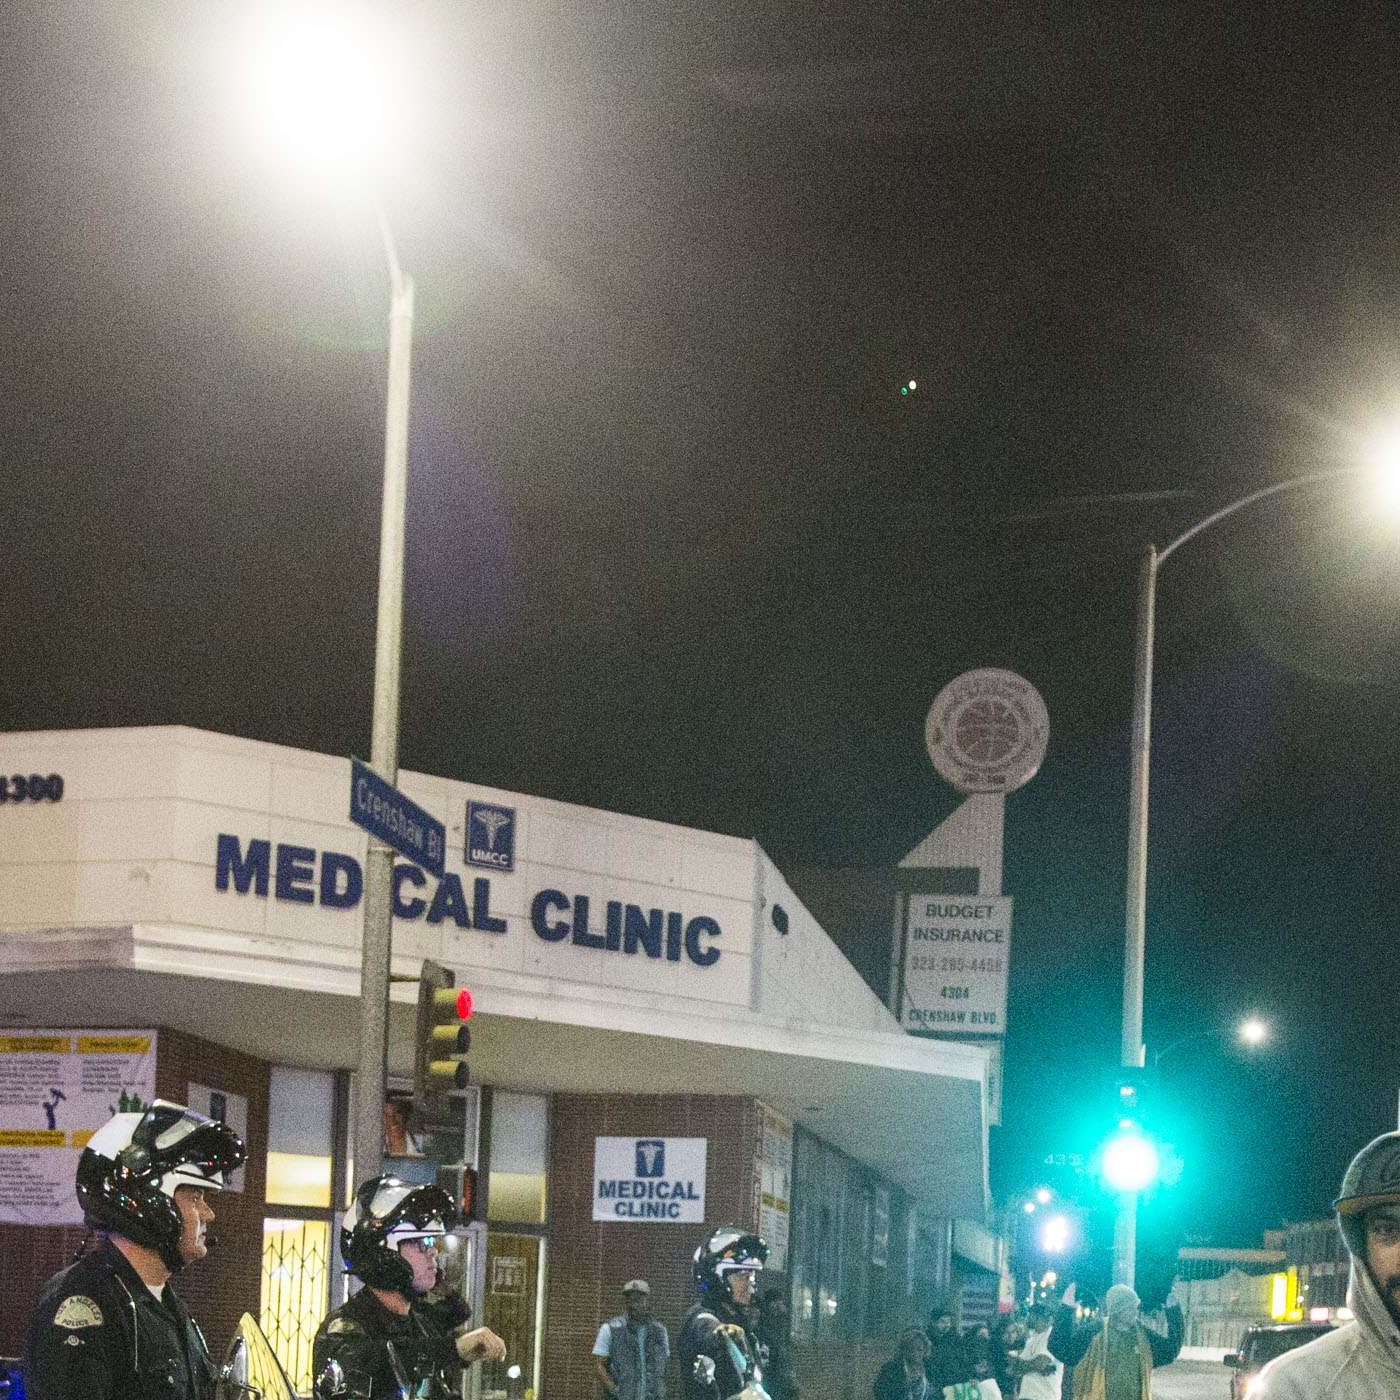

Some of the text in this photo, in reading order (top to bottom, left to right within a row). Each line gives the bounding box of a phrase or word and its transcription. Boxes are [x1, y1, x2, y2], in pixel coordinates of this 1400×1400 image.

[356, 777, 425, 850] Crenshaw
[471, 850, 509, 864] UMCC
[215, 832, 721, 967] MEDCAL CLINIC
[925, 904, 994, 919] BUDGET
[913, 928, 1005, 943] INSURANCE
[909, 1008, 967, 1024] CRENSHAW
[599, 1180, 699, 1200] MEDICAL
[614, 1202, 680, 1219] CLINIC
[61, 1318, 90, 1327] POLICE
